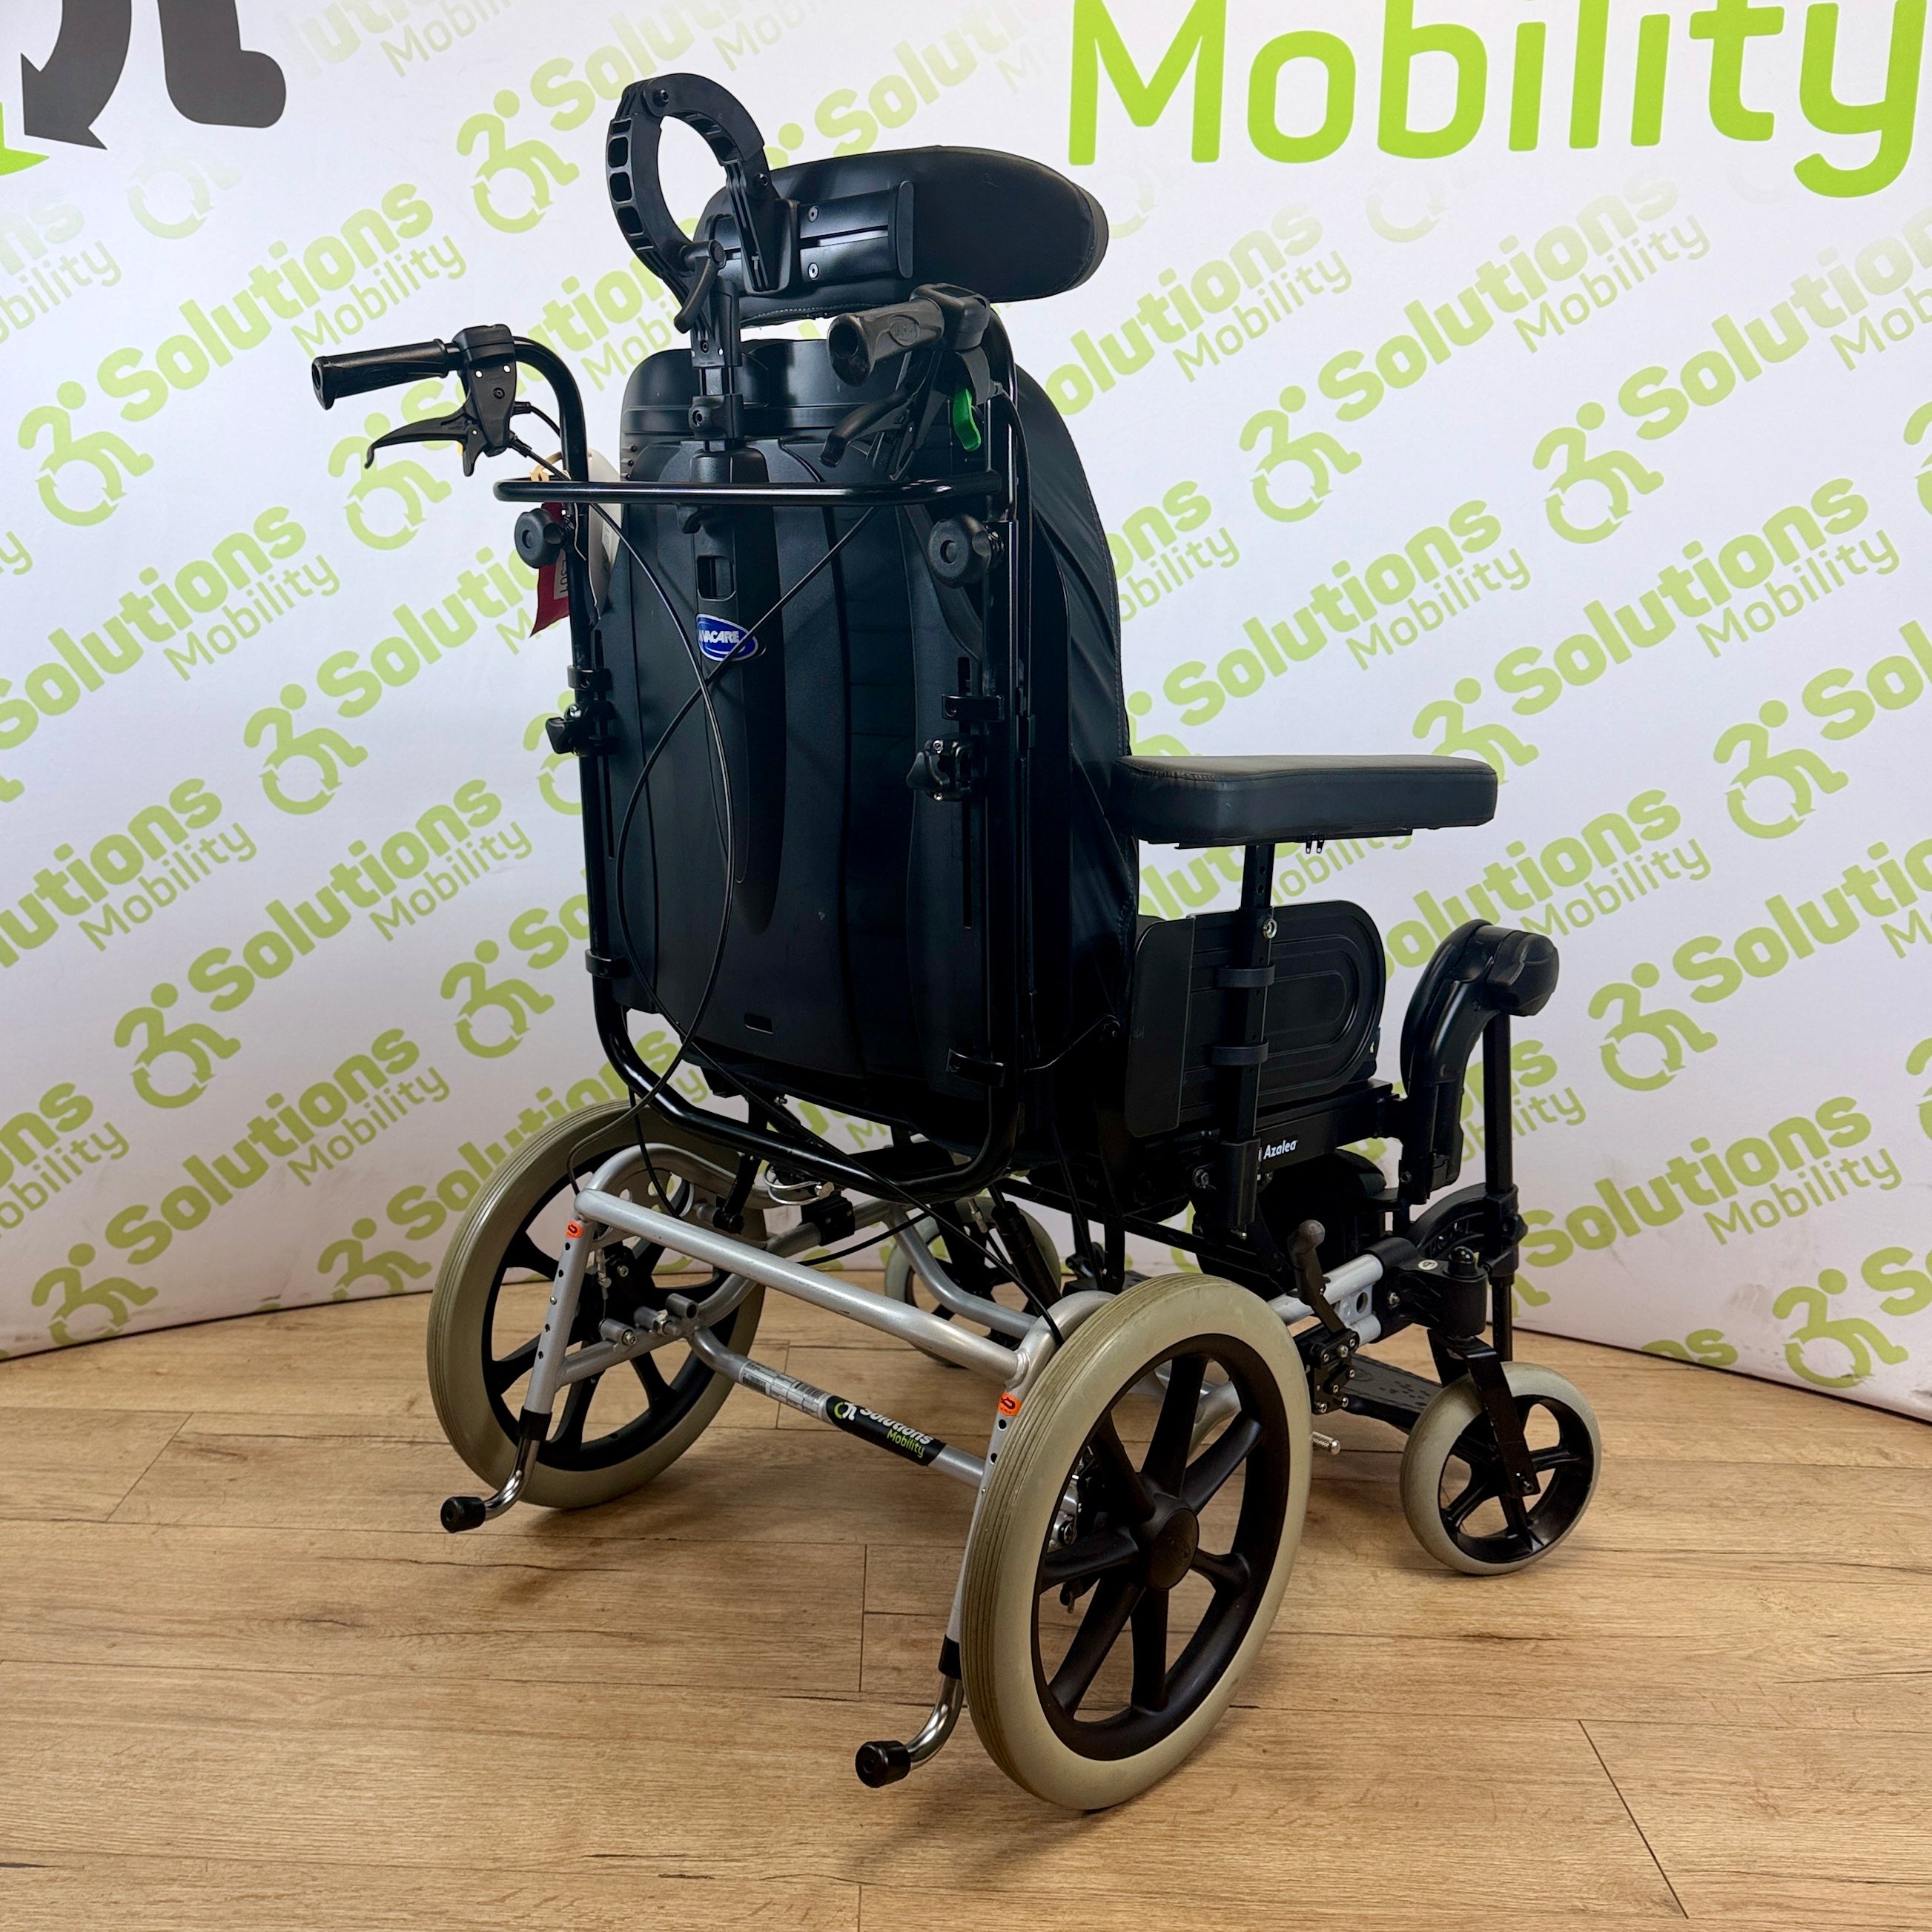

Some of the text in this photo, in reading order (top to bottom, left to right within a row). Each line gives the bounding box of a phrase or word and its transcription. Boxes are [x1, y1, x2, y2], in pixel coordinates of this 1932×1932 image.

[380, 0, 512, 77] Mobi
[1068, 0, 1928, 198] Mobility
[98, 183, 434, 422] Solutions
[291, 235, 466, 355] Mobility
[1046, 202, 1323, 416] olutions
[1172, 251, 1352, 382] Mobility
[1318, 165, 1679, 422] Solutions
[1512, 214, 1711, 354] Mobility
[163, 555, 340, 681] Mobility
[1119, 527, 1240, 622] obility
[1163, 500, 1501, 726] Solutions
[1346, 548, 1531, 670] Mobility
[1495, 477, 1869, 715] Solutions
[1696, 529, 1900, 658] Mobility
[79, 823, 257, 952] Mobility
[188, 779, 503, 1012] Solutions
[369, 821, 532, 942] Mobility
[1386, 790, 1681, 981] olutions
[1519, 838, 1711, 936] Mobility
[0, 1122, 129, 1238] obility
[105, 1028, 420, 1265] Solutions
[287, 1066, 450, 1186] Mobility
[1263, 1139, 1297, 1160] Azalea
[1521, 1096, 1872, 1268] Solutions
[1704, 1148, 1902, 1245] Mobility
[887, 1429, 925, 1458] Mobility
